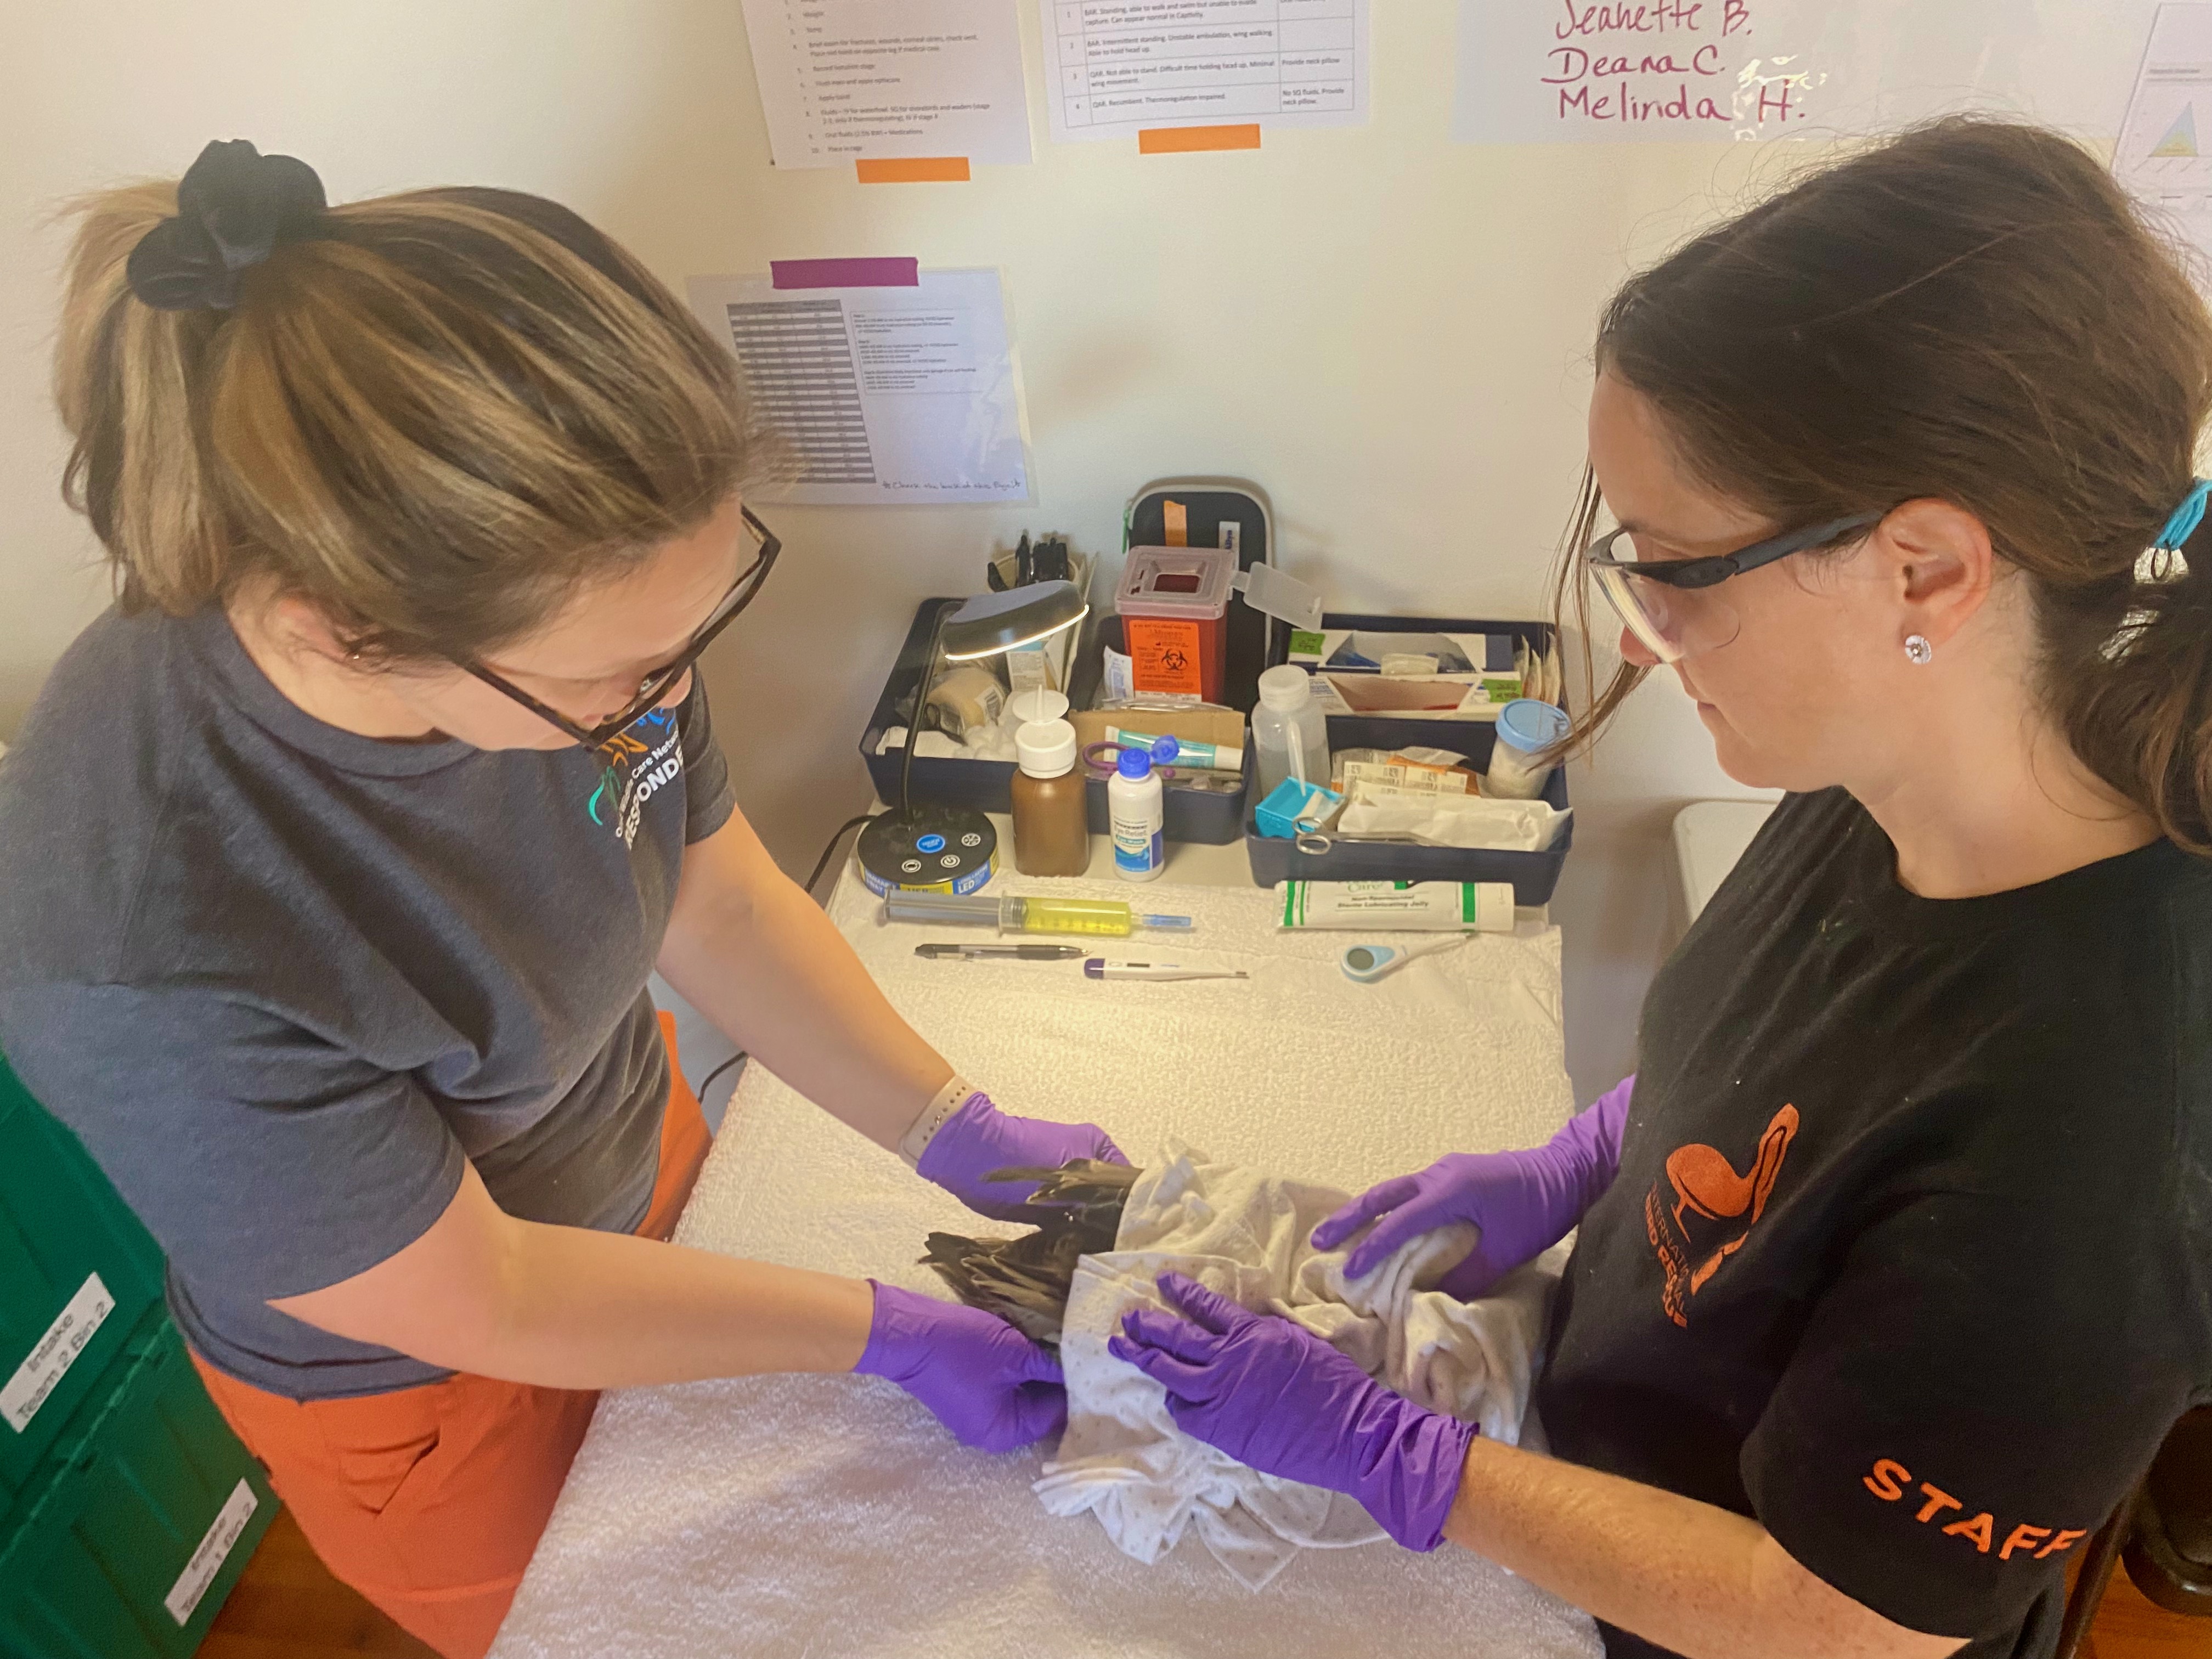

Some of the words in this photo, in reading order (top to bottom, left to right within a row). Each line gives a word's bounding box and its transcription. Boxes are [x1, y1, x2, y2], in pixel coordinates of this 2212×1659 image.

[1556, 0, 1703, 40] Jeanette
[1722, 0, 1753, 37] B.
[1541, 47, 1689, 83] Deana
[1692, 44, 1725, 75] C.
[1559, 81, 1733, 122] Melinda
[1757, 78, 1805, 122] H.
[958, 879, 975, 894] LED
[1863, 1458, 2087, 1561] STAFF
